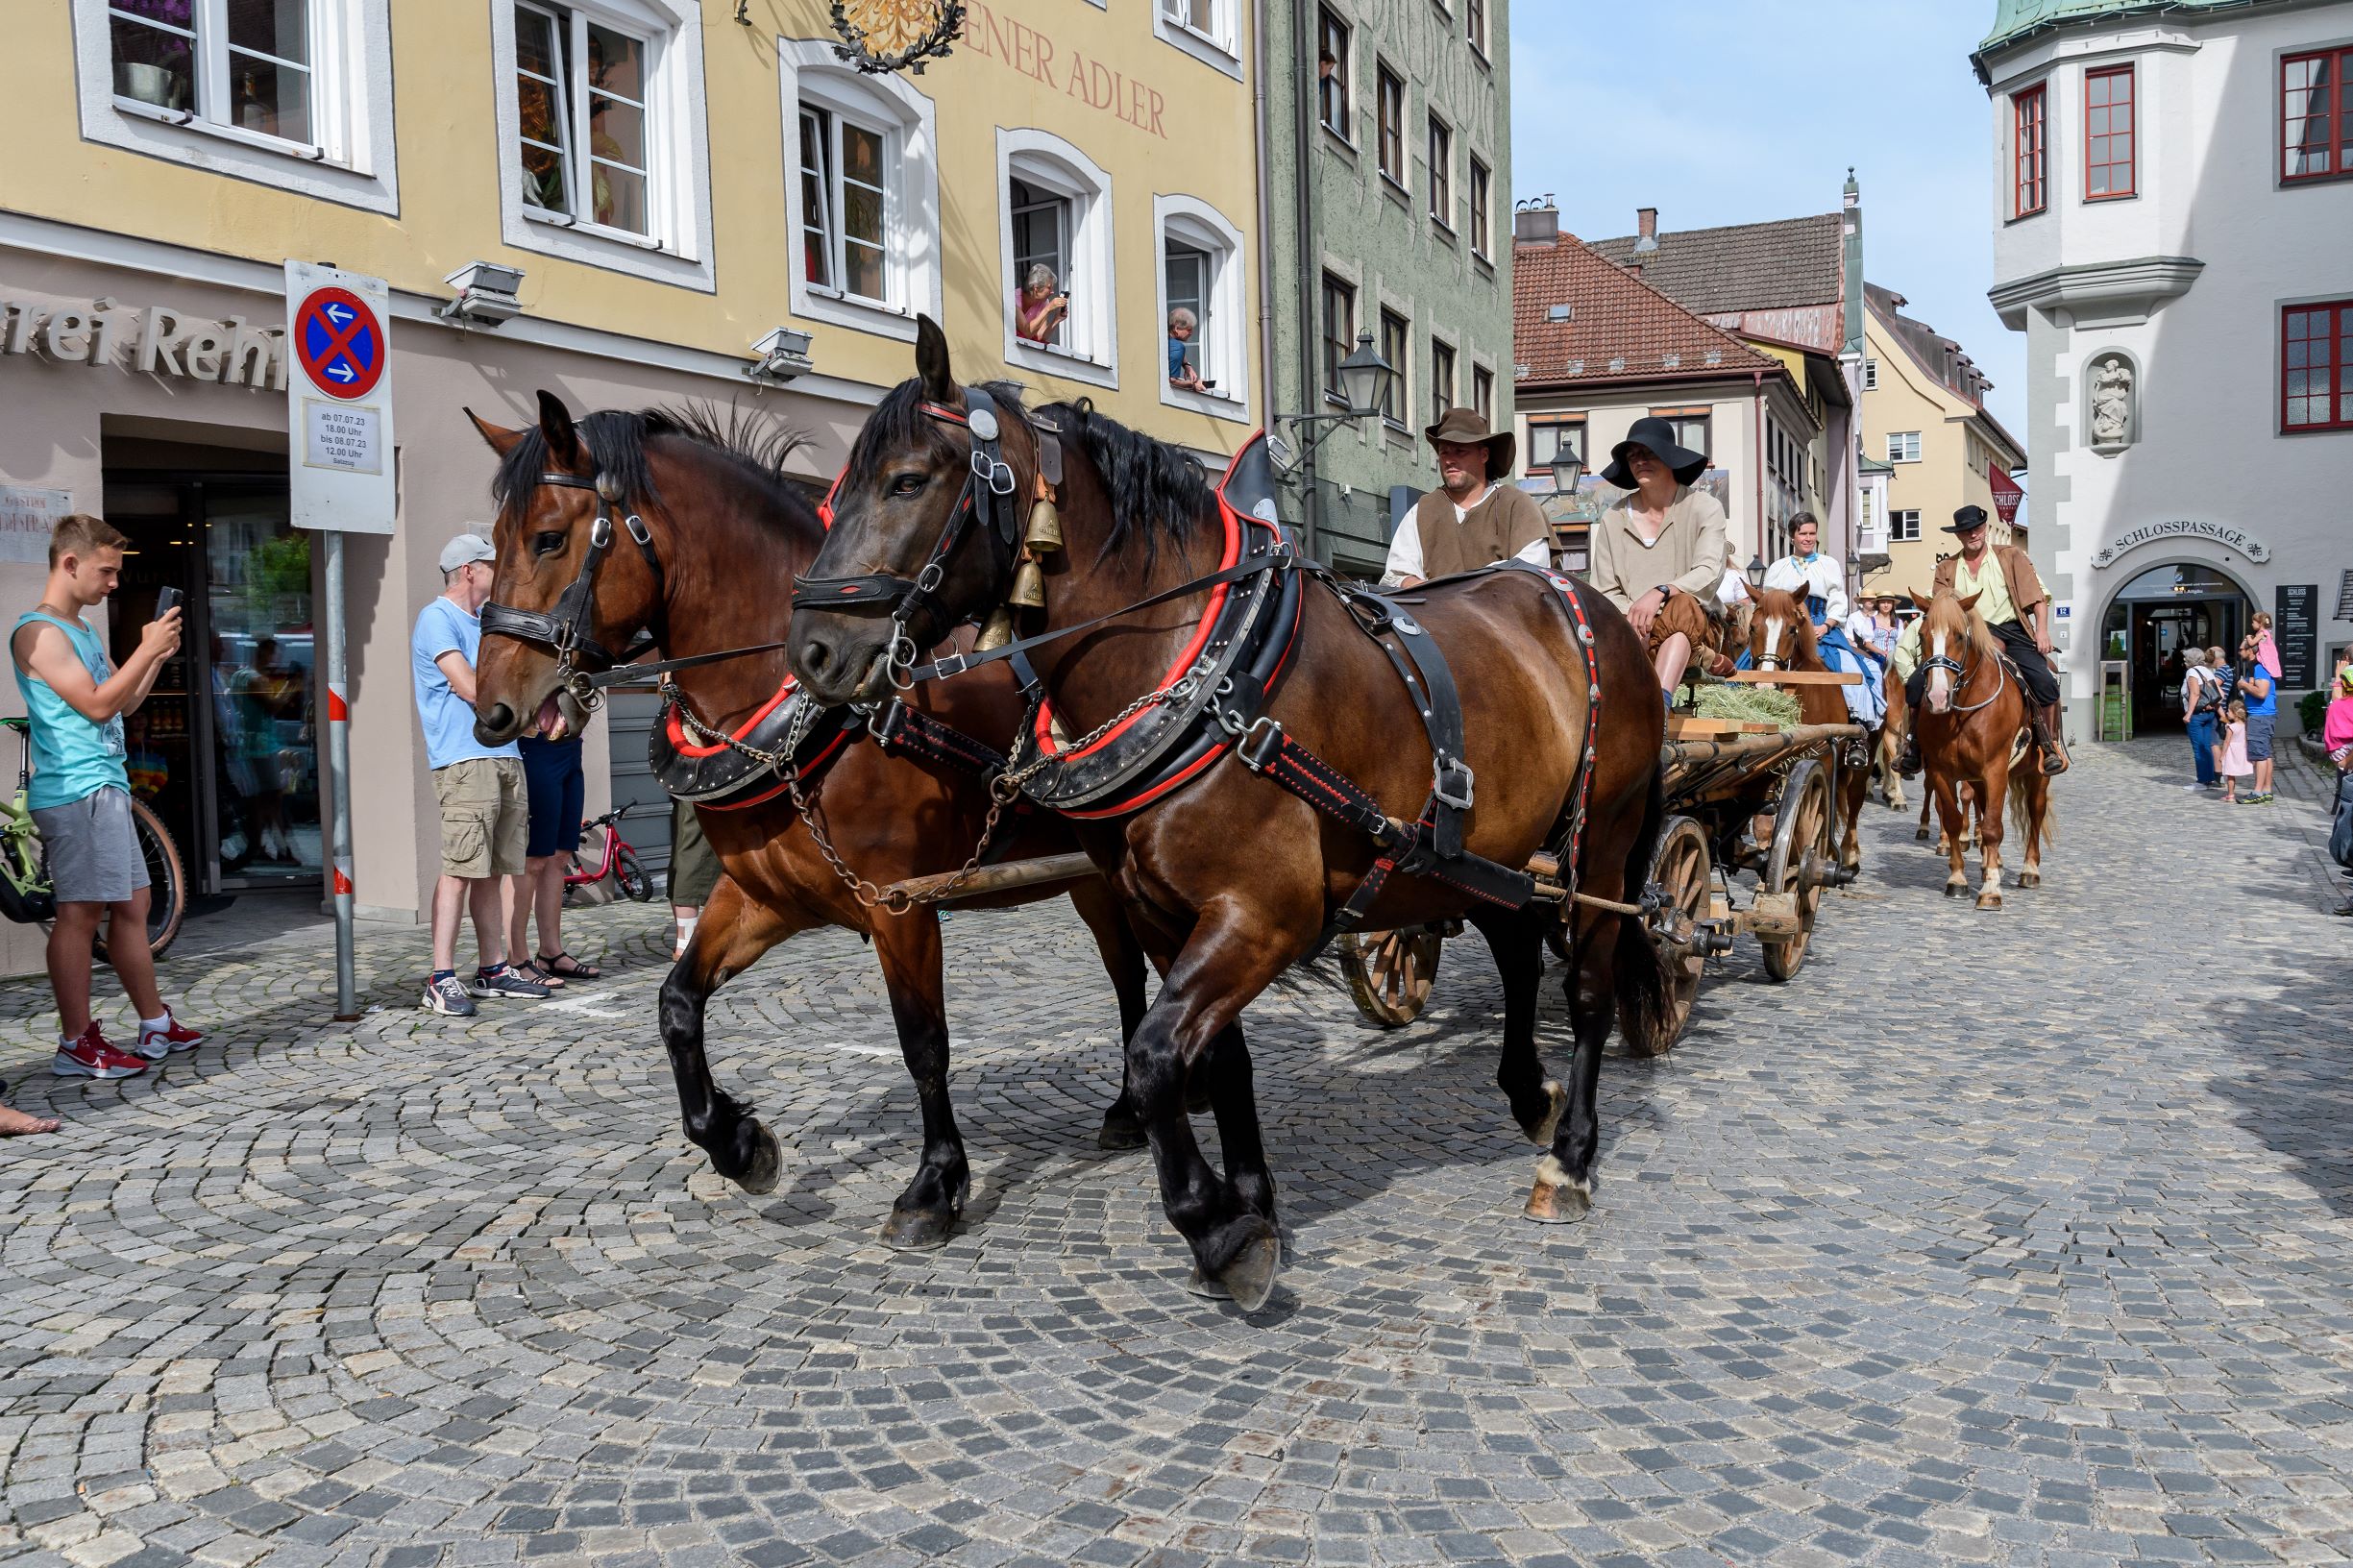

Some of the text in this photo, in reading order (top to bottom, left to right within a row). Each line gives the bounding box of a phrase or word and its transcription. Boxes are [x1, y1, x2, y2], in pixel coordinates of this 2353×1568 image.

[962, 0, 1167, 140] ENER ADLER
[1, 296, 116, 366] rei
[321, 412, 365, 427] ab 07.07.23
[325, 424, 362, 436] 18.00 Uhr
[320, 433, 367, 449] bis 08.07.23
[325, 446, 363, 458] 12.00 Uhr
[2115, 521, 2246, 551] SCHLOSSPASSAGE
